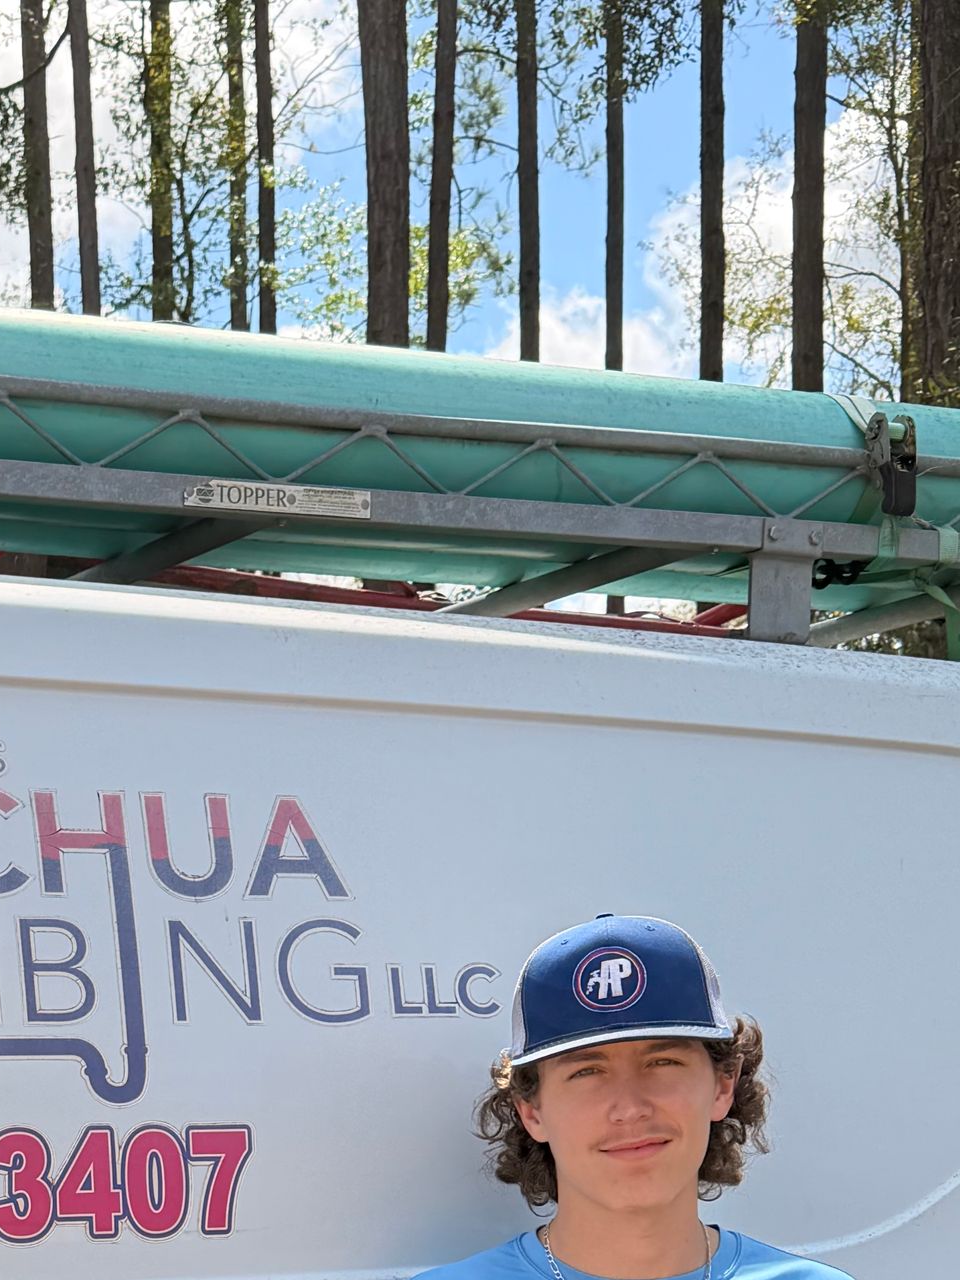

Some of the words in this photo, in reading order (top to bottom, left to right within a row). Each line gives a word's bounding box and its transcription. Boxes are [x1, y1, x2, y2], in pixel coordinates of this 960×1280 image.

[216, 484, 288, 508] TOPPER
[389, 964, 502, 1017] LLC
[598, 957, 632, 1000] AP
